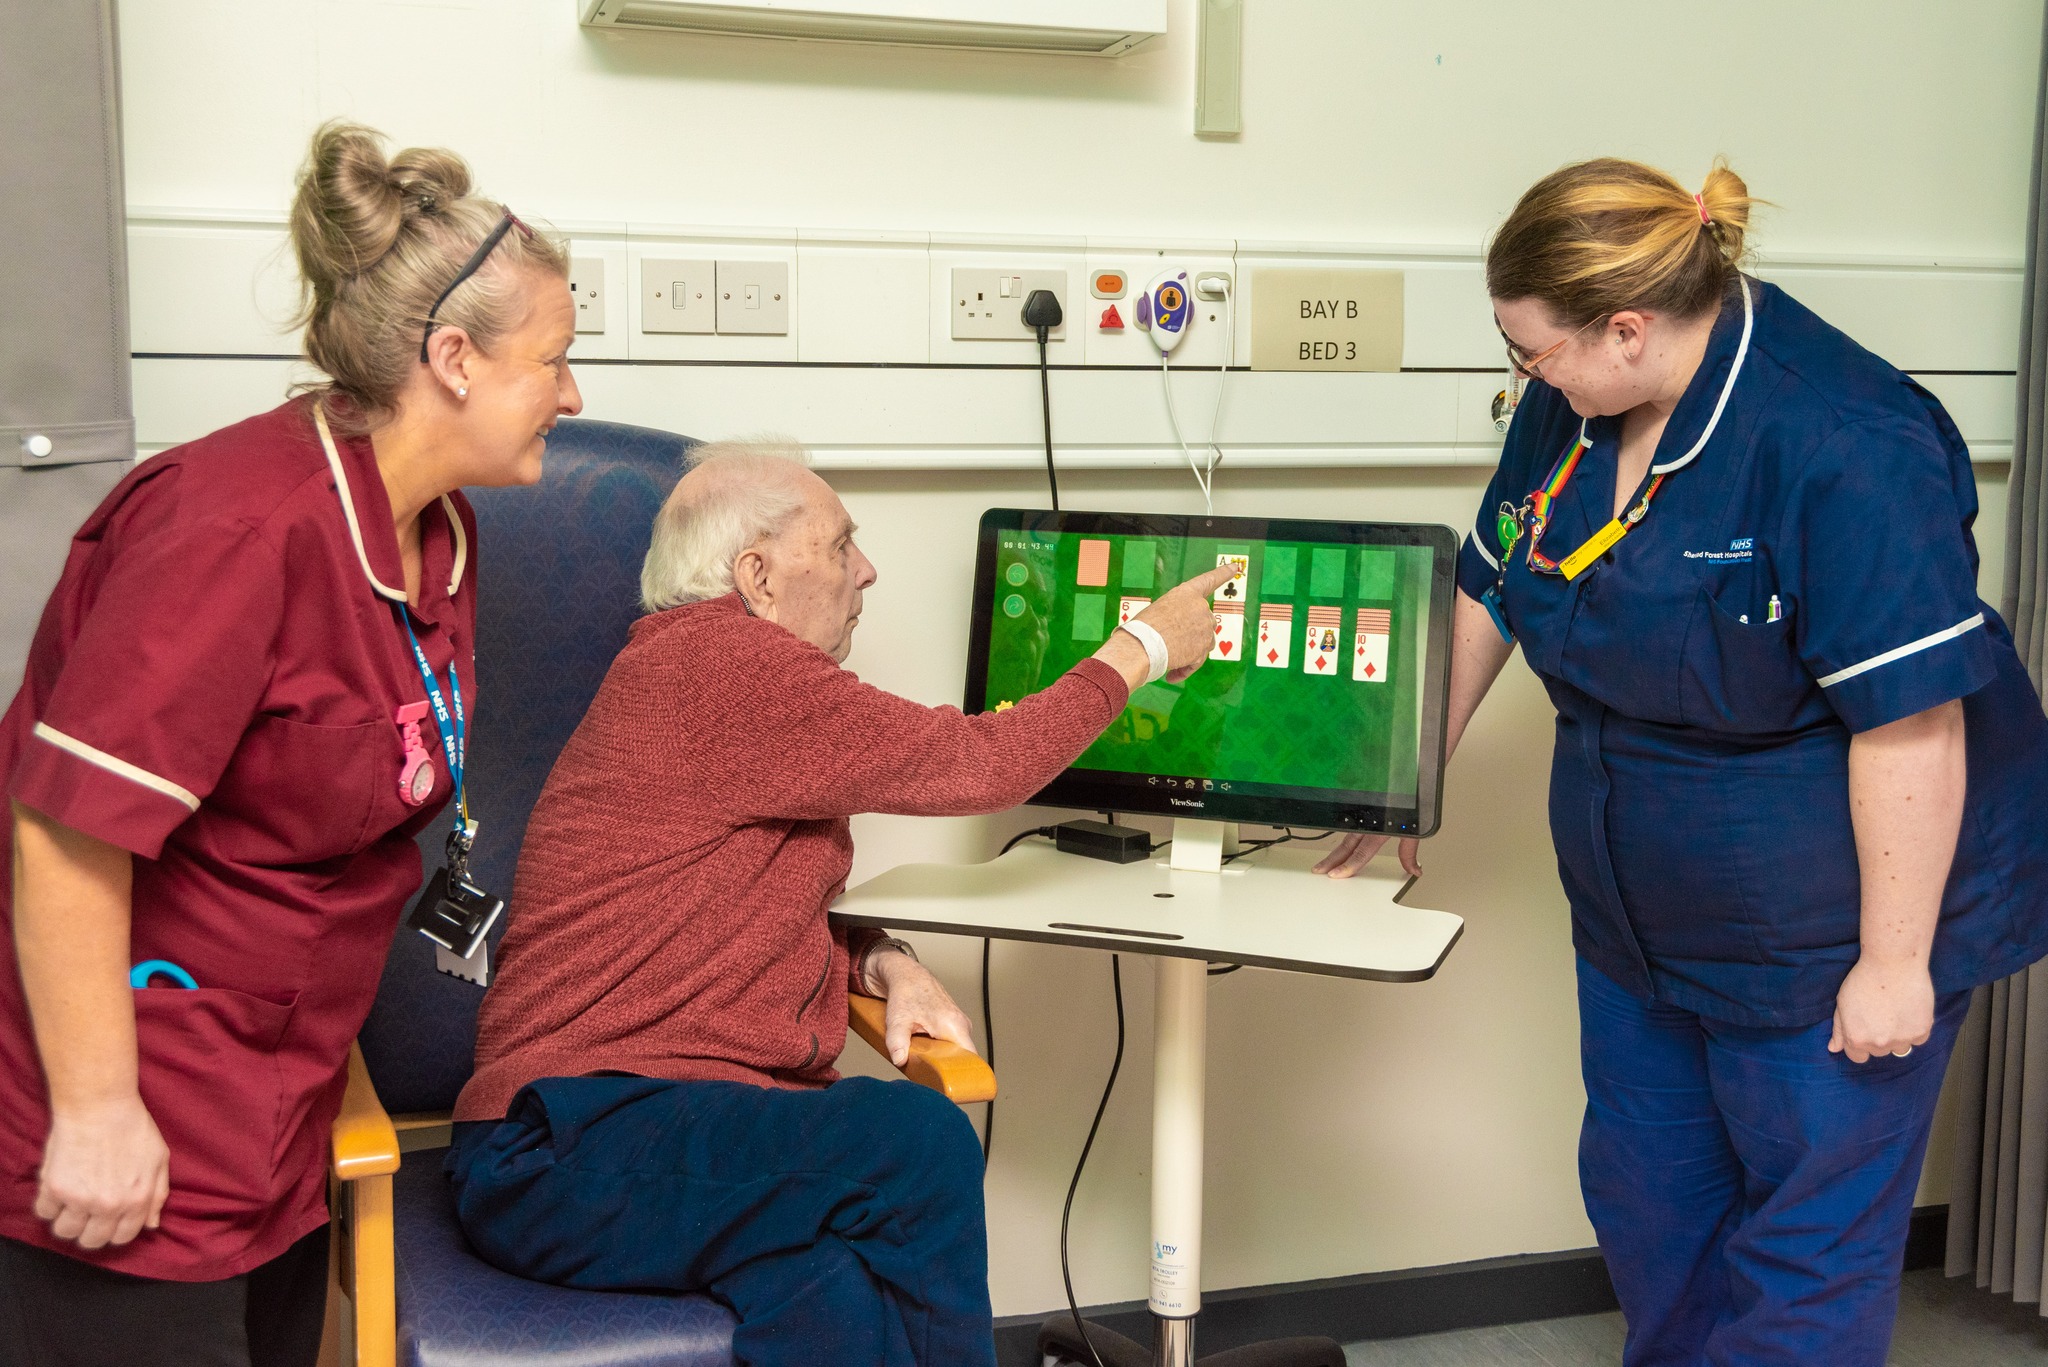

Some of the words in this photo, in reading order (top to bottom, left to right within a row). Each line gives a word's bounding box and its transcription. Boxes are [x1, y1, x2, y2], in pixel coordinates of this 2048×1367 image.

[1300, 300, 1339, 319] BAY
[1346, 300, 1358, 319] B
[1299, 342, 1339, 360] BED
[1345, 342, 1356, 360] 3
[1730, 539, 1752, 549] NHS
[1725, 551, 1752, 559] Hospitals
[1122, 601, 1130, 611] 6
[1261, 621, 1268, 631] 4
[1309, 628, 1316, 637] Q
[1357, 634, 1367, 645] 10
[415, 645, 432, 677] NHS
[431, 690, 449, 722] NHS
[445, 734, 457, 767] NHS
[1170, 798, 1205, 808] ViewSonic
[1163, 1245, 1177, 1255] my
